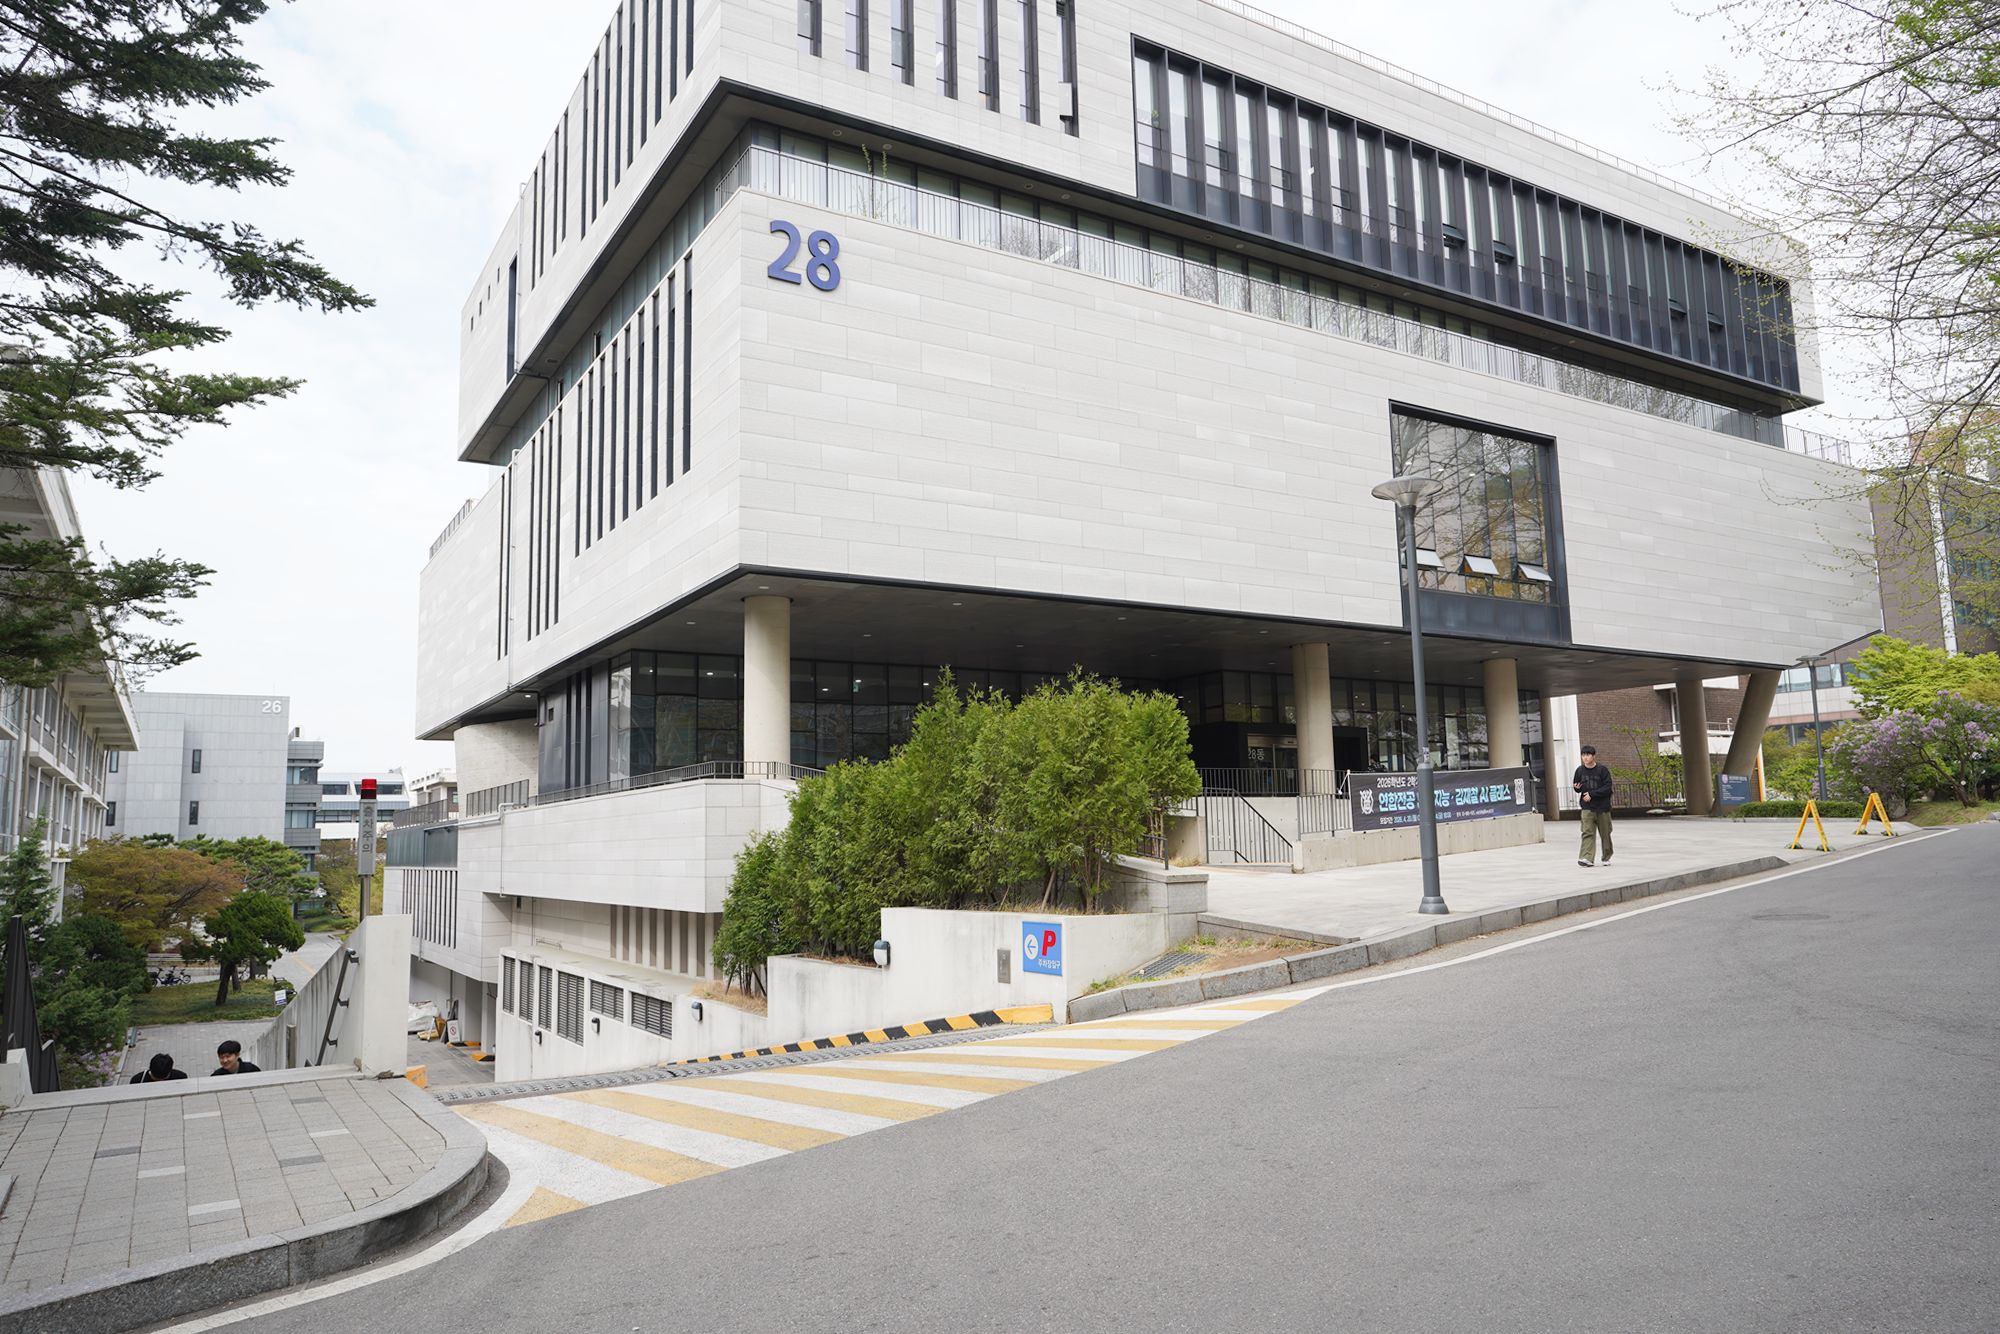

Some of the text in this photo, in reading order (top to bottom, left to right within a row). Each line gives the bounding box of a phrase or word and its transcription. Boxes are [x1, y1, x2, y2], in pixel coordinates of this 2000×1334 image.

[767, 219, 841, 291] 28
[262, 700, 282, 713] 26
[1247, 748, 1265, 760] 28동
[1379, 791, 1416, 812] 연합전공
[361, 805, 374, 854] 출차주의
[1041, 930, 1057, 957] P
